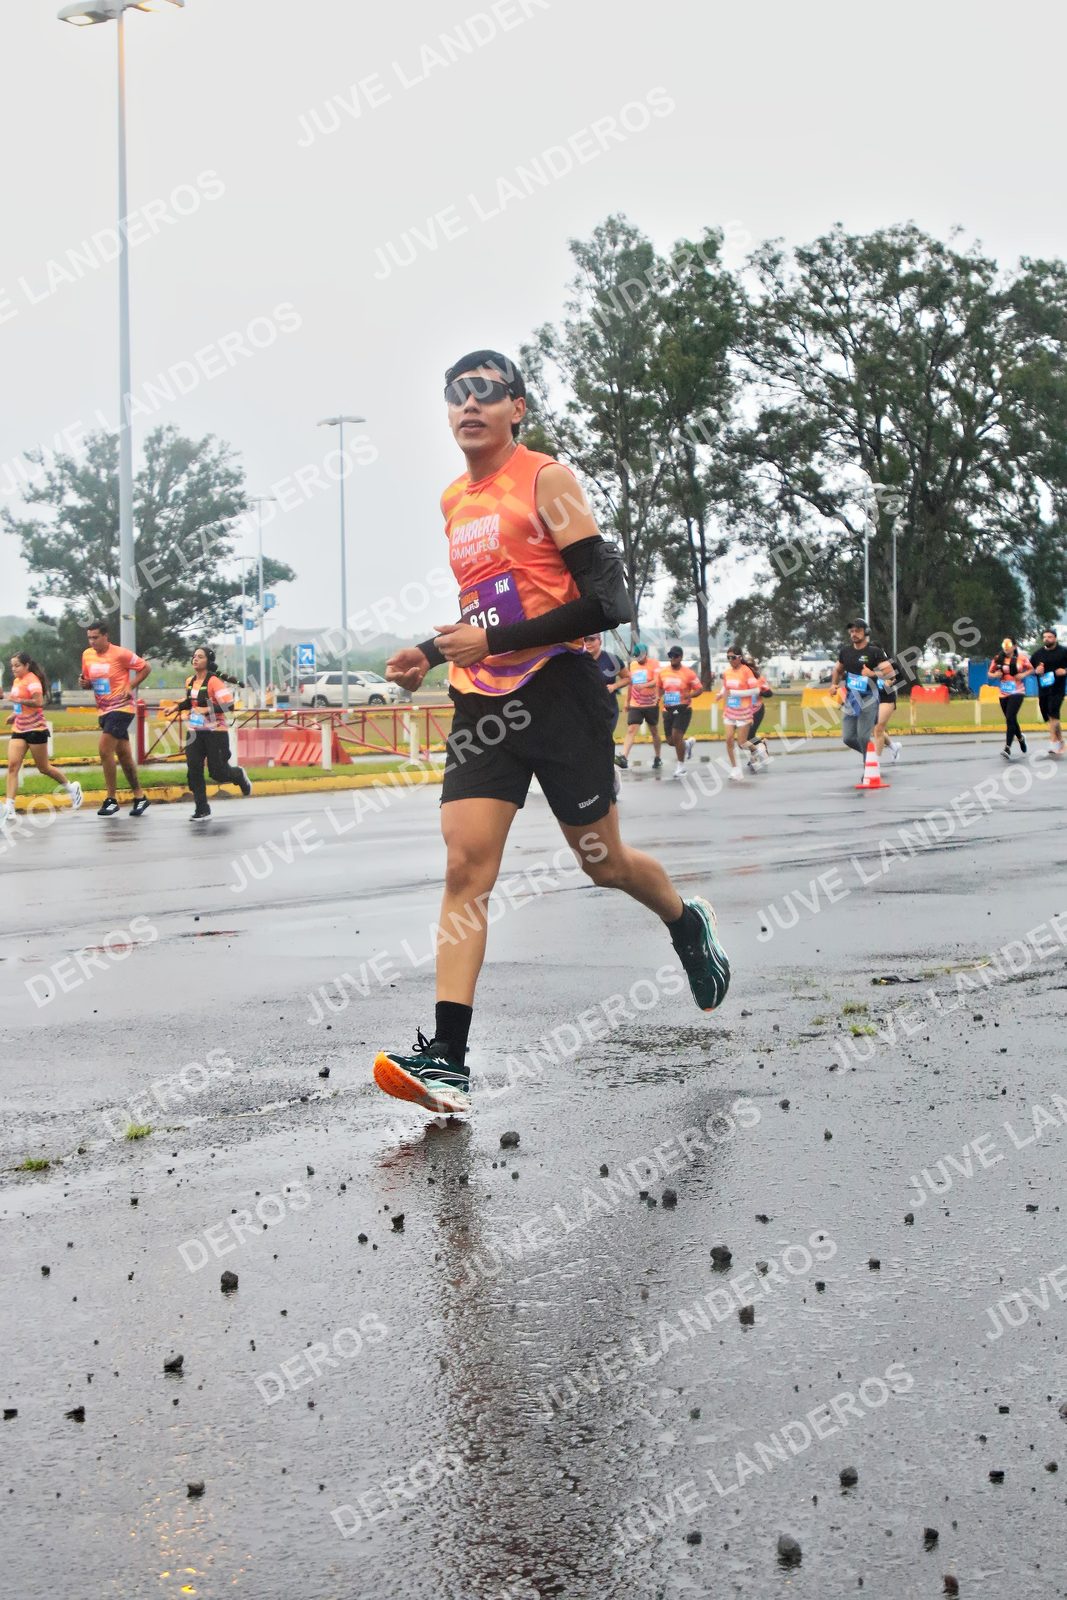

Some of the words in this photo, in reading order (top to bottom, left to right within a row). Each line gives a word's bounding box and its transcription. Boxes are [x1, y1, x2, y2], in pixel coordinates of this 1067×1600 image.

[452, 514, 500, 545] CARRERA
[451, 540, 488, 560] OMNILIFE
[469, 607, 500, 630] 816
